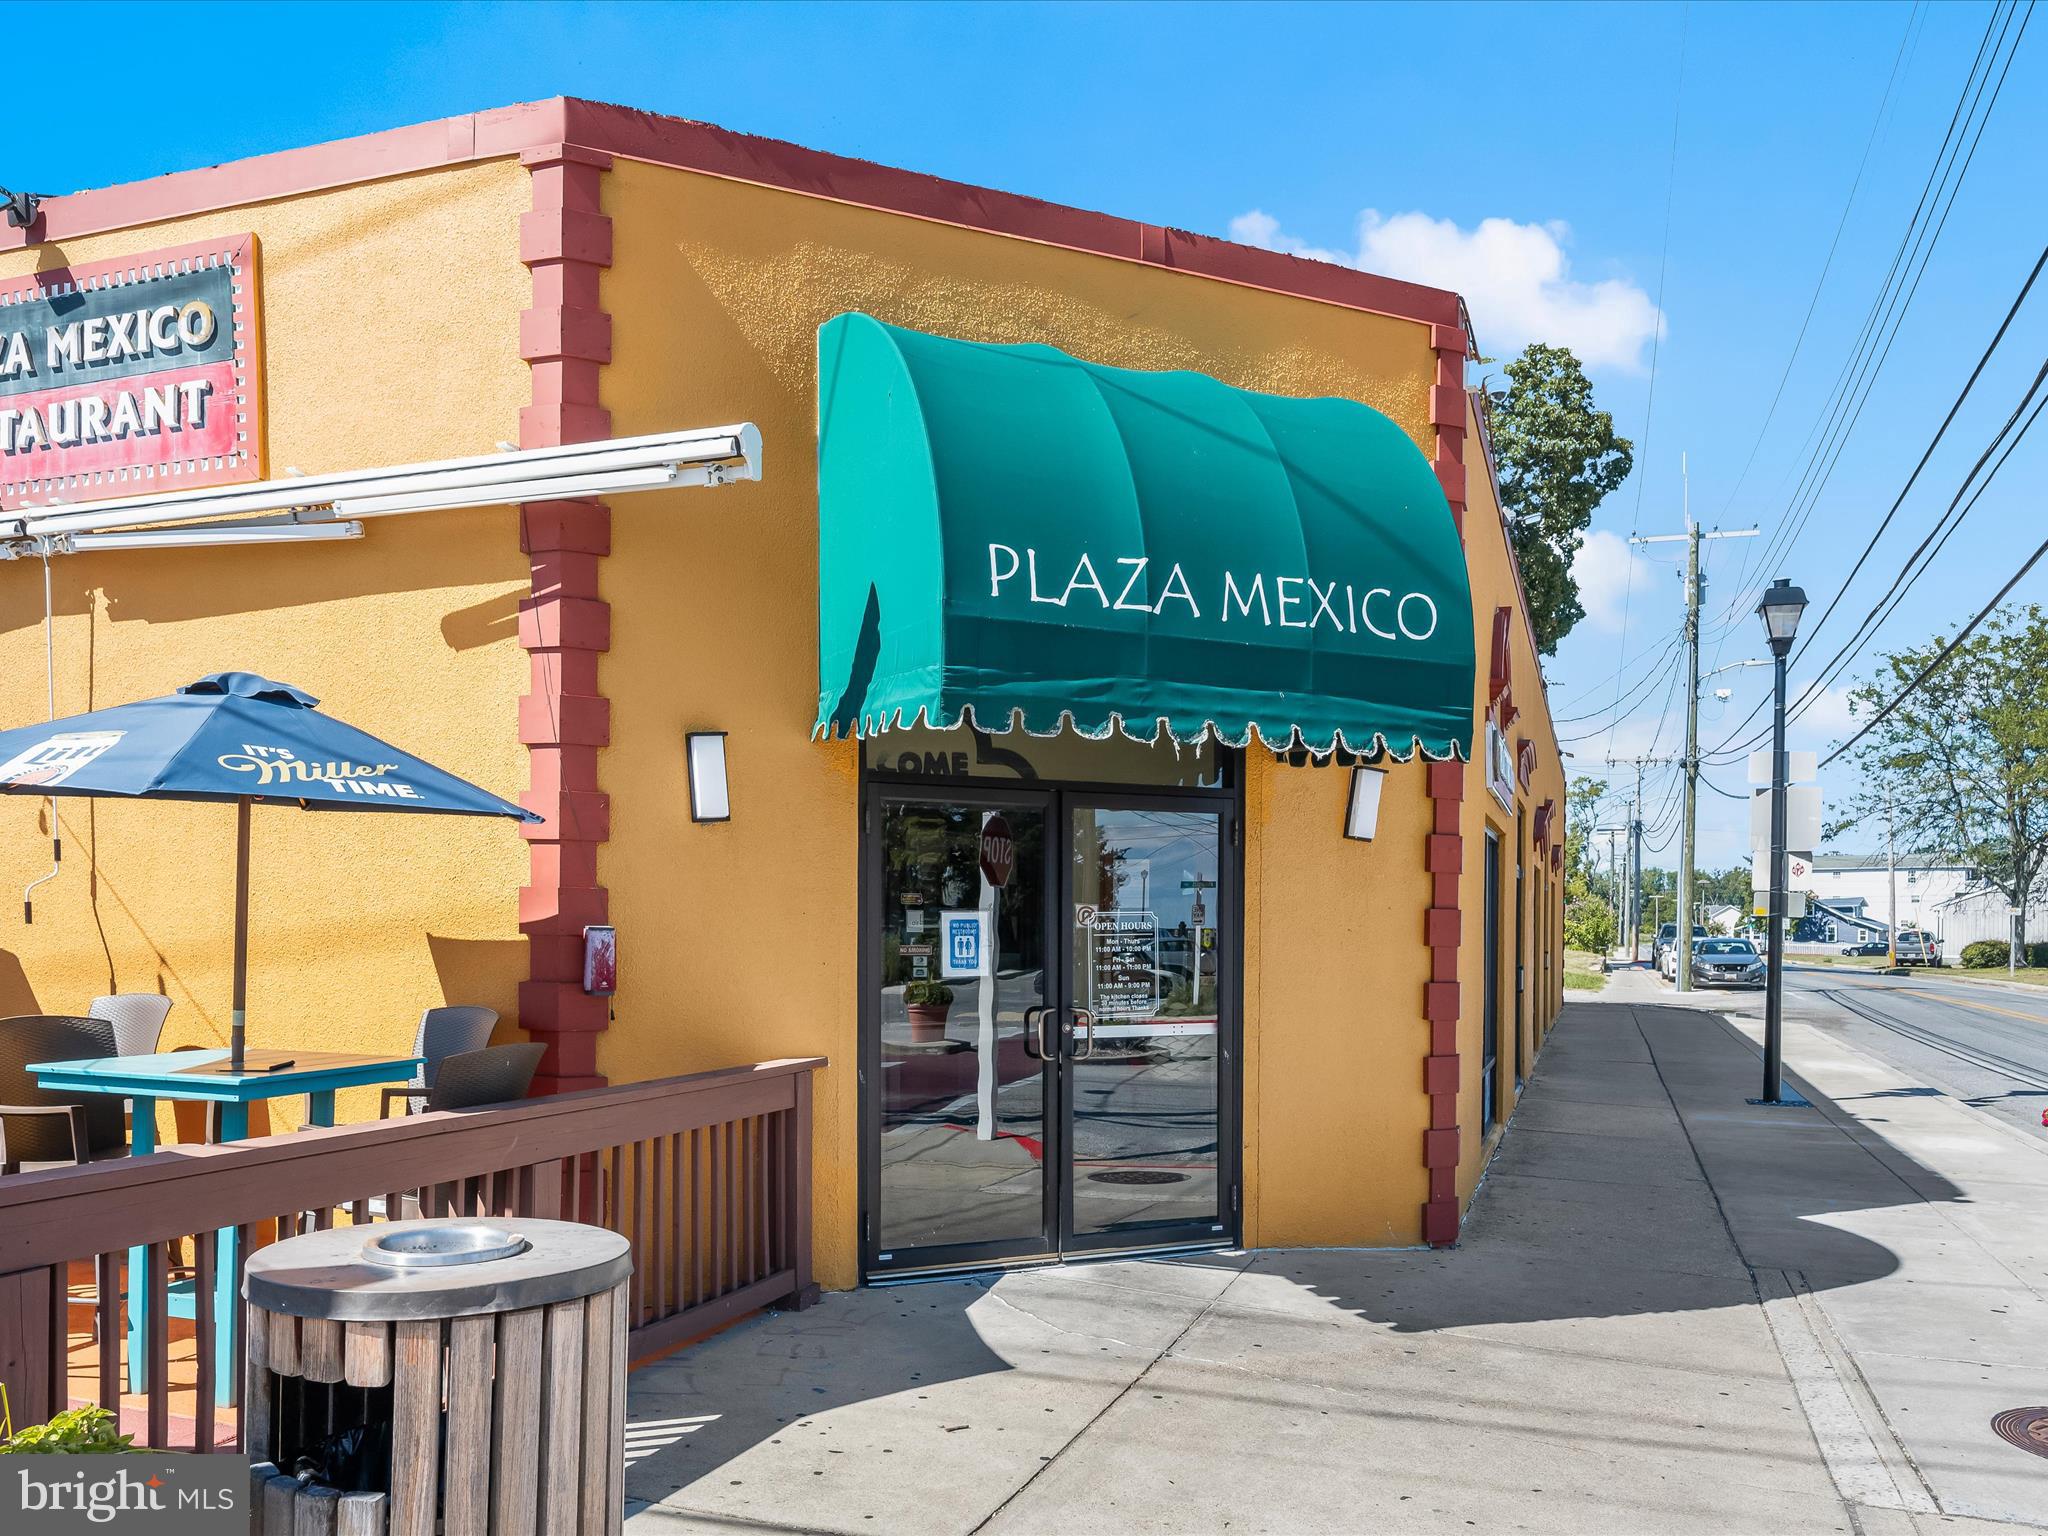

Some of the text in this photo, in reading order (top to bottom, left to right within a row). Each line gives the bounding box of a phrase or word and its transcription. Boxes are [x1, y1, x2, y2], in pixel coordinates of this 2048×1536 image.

[0, 300, 216, 376] A MEXICO
[0, 380, 210, 451] TAURANT
[988, 543, 1438, 641] PLAZA MEXICO
[217, 754, 398, 785] Miller
[241, 744, 296, 761] IT'S
[1094, 921, 1152, 930] OPEN HOURS
